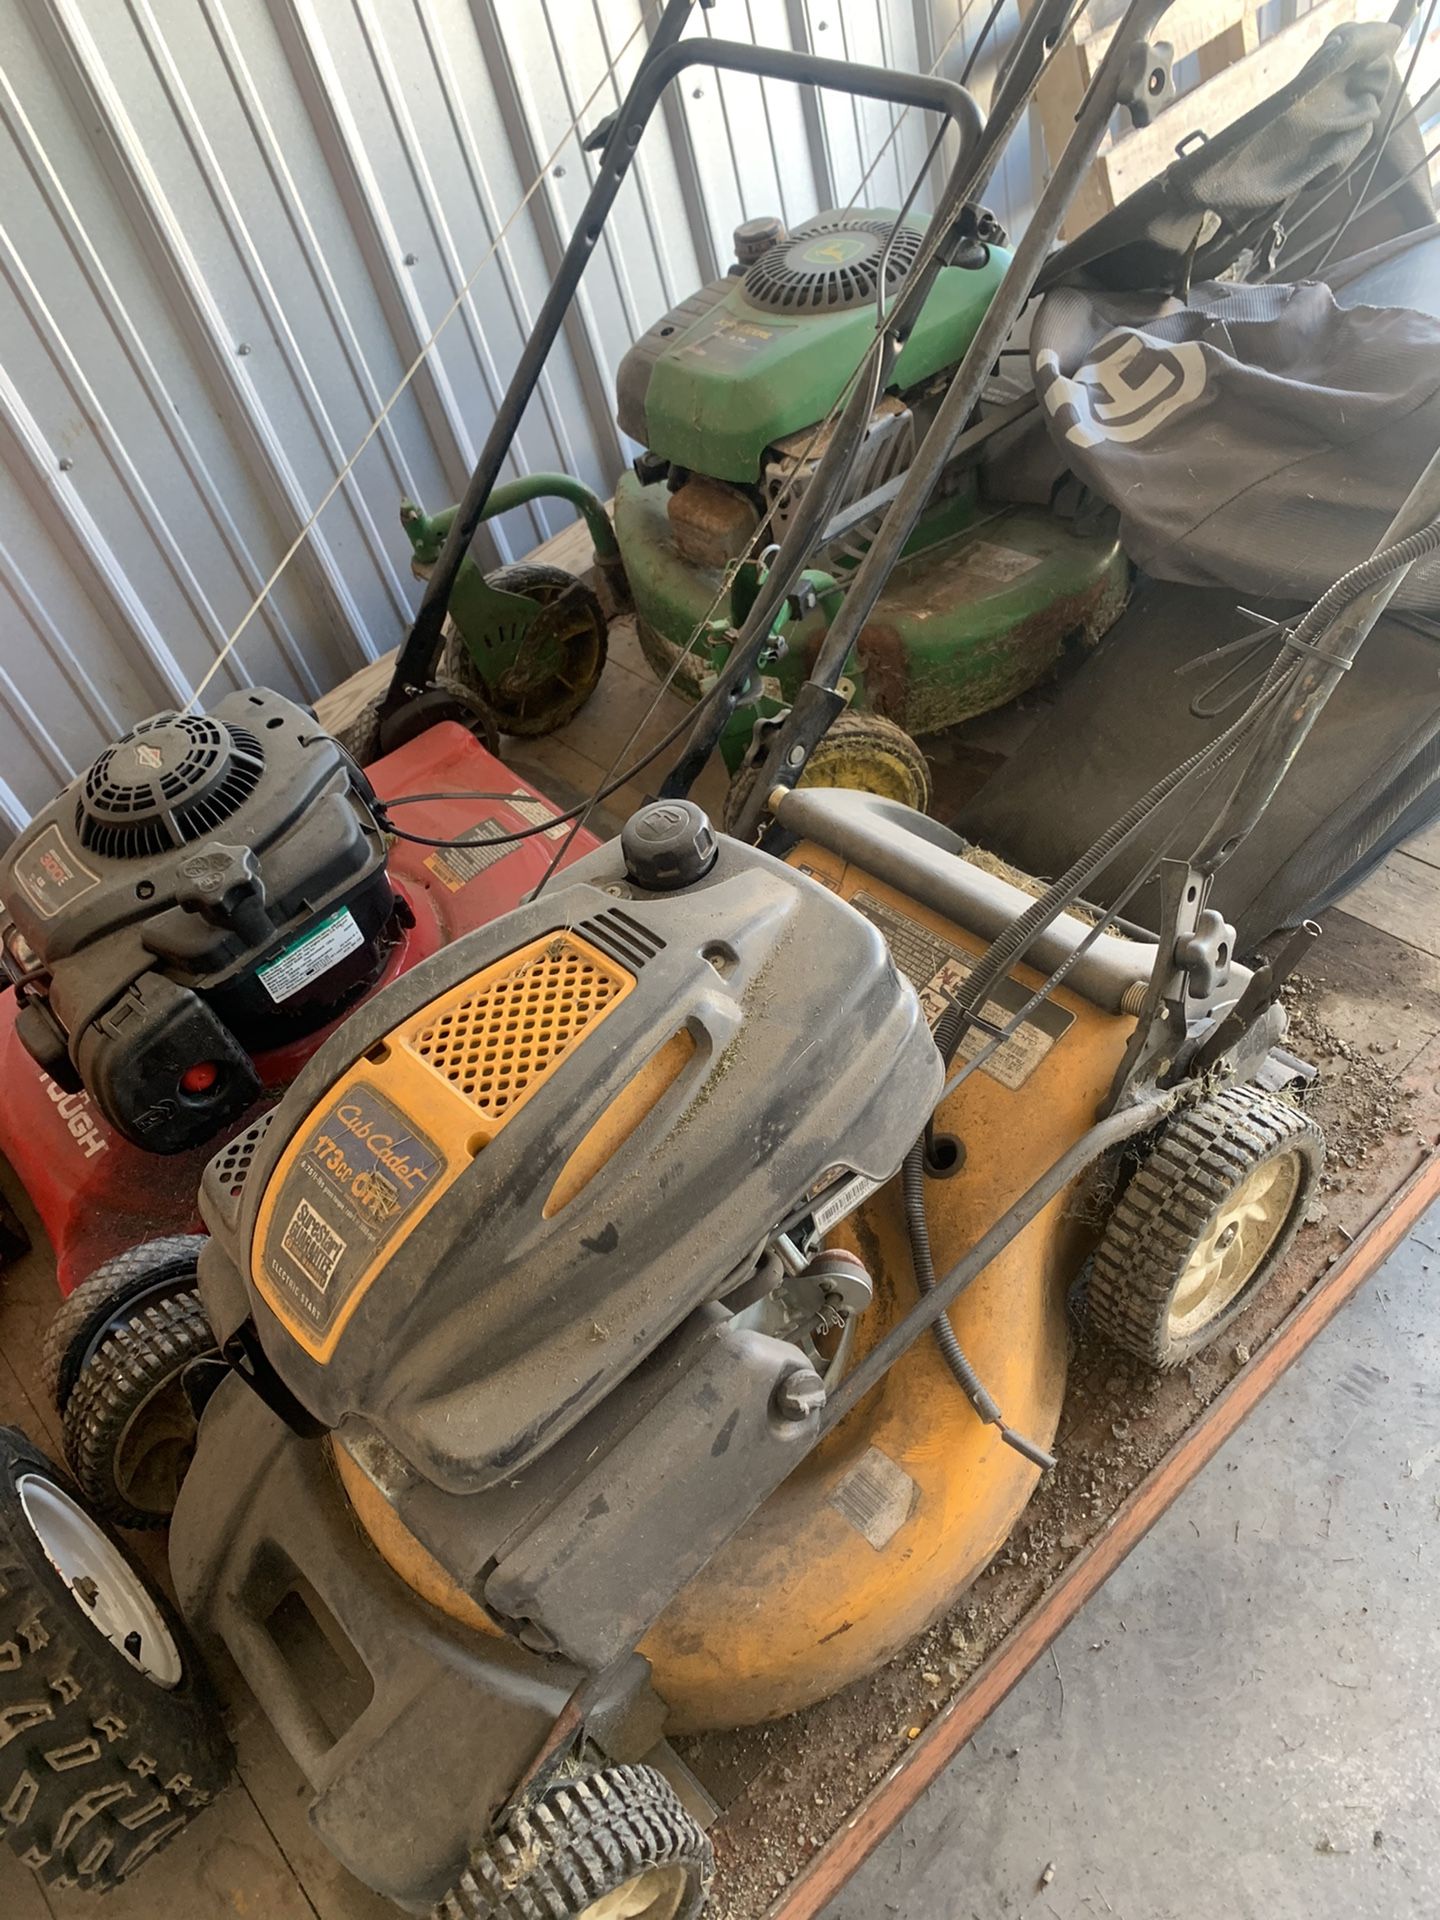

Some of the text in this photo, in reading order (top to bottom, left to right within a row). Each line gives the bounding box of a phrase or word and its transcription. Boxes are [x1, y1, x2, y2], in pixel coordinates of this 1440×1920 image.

[312, 1135, 353, 1184] 173cc
[337, 1105, 428, 1190] Cub Cadet
[288, 1221, 335, 1275] GUARANTEE
[298, 1203, 344, 1260] SureStart
[271, 1259, 299, 1297] ELECTRIC
[300, 1292, 322, 1321] START
